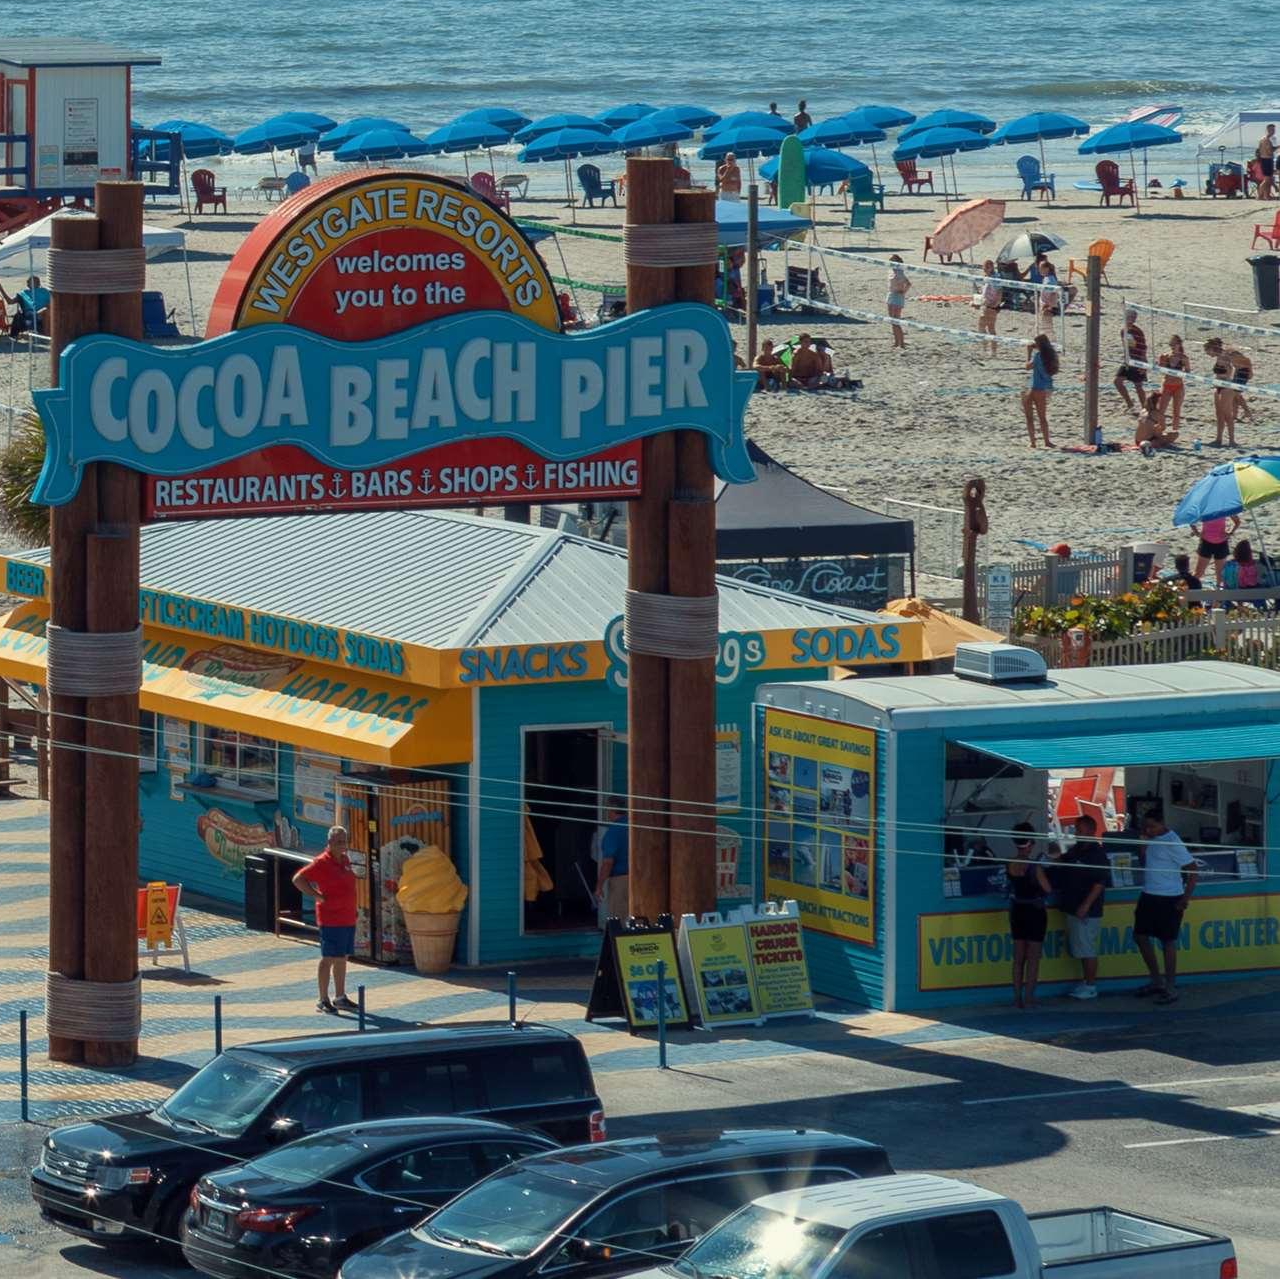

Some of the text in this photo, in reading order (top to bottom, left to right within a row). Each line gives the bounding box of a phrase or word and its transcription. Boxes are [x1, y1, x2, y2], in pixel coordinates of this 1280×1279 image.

[252, 188, 542, 314] WESTGATE RESORTS
[336, 248, 466, 274] welcomes
[336, 282, 466, 313] you to the
[91, 329, 708, 454] COCOA BEACH PIER
[154, 460, 638, 508] RESTAURANTS BARS SHOPS FISHING
[798, 562, 888, 593] Coast
[7, 560, 45, 596] BEER
[184, 598, 244, 640] CREAM
[250, 613, 288, 651] HOT
[289, 618, 339, 662] DOGS
[344, 631, 405, 677] SODAS
[792, 625, 901, 663] SODAS
[459, 644, 588, 683] SNACKS
[793, 729, 816, 745] ABOUT
[750, 923, 798, 937] HARBOR
[756, 937, 798, 950] CRUISE
[1199, 917, 1279, 950] CENTER
[753, 950, 803, 965] TICKETS
